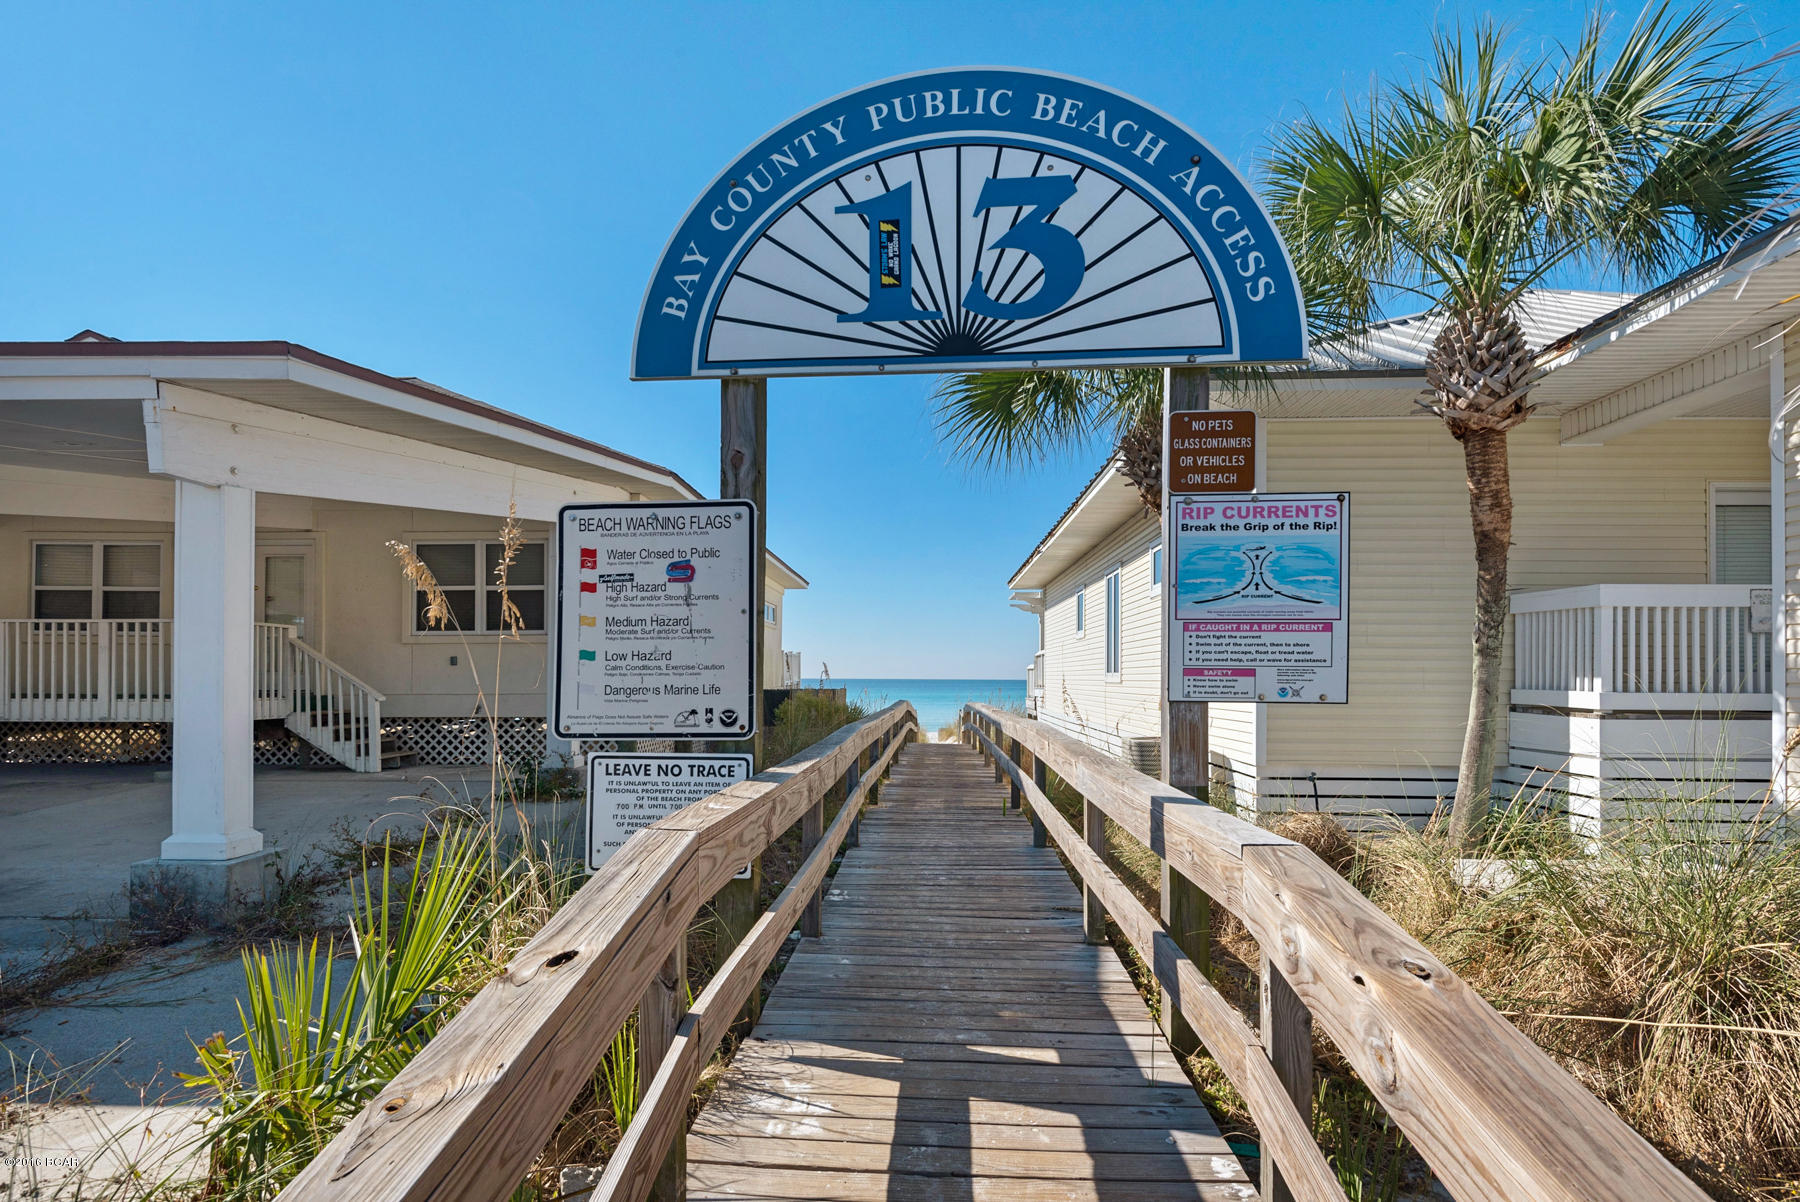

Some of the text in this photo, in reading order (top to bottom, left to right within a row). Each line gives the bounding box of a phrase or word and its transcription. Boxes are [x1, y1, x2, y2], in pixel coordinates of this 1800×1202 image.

[661, 88, 1276, 320] BAY COUNTY PUBLIC BEACH ACCESS
[835, 174, 1085, 322] 13
[1192, 420, 1234, 431] NO PETS
[1174, 438, 1252, 449] GLASS CONTAINERS
[1180, 456, 1245, 466] OR VEHICLES
[1187, 474, 1237, 484] ON BEACH
[1181, 504, 1337, 520] RIP CURRENTS
[579, 514, 732, 532] BEACH WARNING FLAGS
[1181, 521, 1337, 534] Break the Grip of the Rip!
[607, 547, 720, 560] Water Closed to Public
[606, 581, 667, 595] High Hazard
[664, 594, 688, 602] Strong
[606, 616, 689, 628] Medium Hazard
[605, 650, 672, 661] Low Hazard
[604, 684, 721, 698] Dangerous Marine Life
[605, 763, 736, 778] LEAVE NO TRACE
